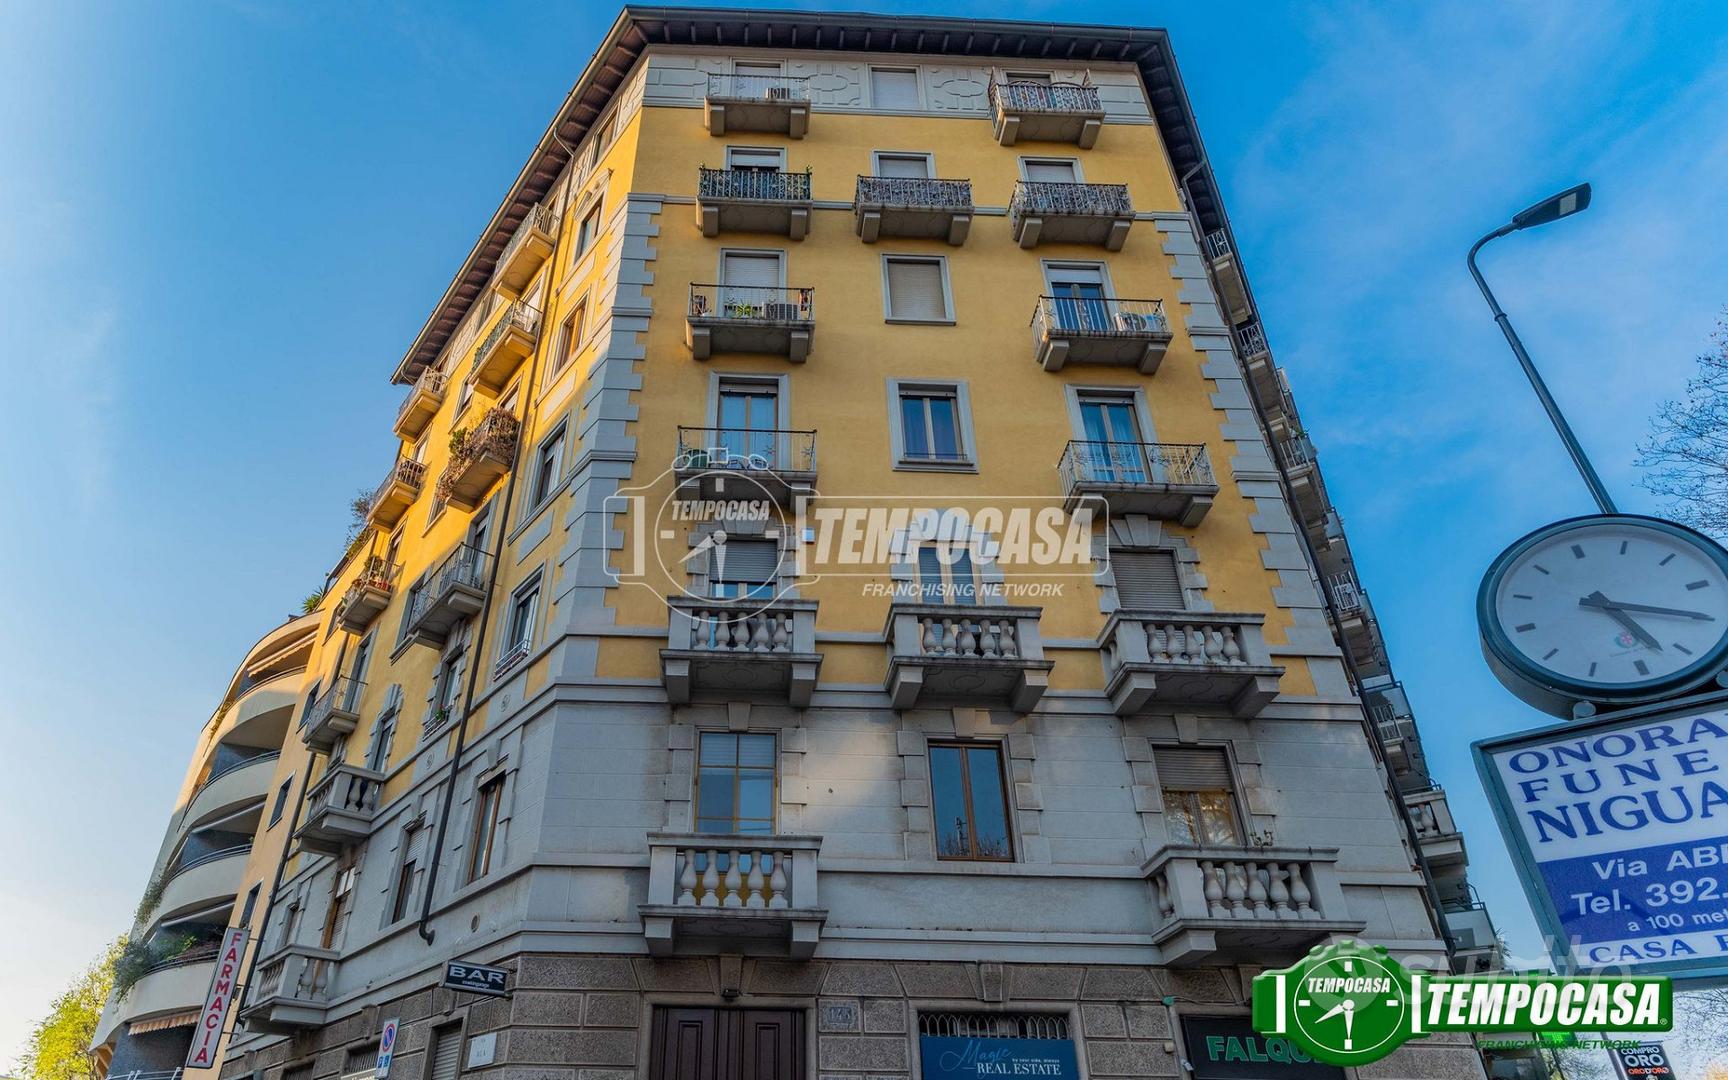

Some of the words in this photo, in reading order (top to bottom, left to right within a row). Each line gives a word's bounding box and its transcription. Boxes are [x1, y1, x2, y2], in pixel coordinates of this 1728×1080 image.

[1509, 713, 1728, 774] ONORA
[1518, 749, 1719, 803] FUNE
[1592, 858, 1648, 880] Via
[1571, 889, 1631, 915] Tel.
[1627, 921, 1640, 932] a
[1646, 914, 1684, 929] 100
[1589, 939, 1698, 963] CASA
[449, 966, 504, 984] BAR
[195, 932, 242, 1063] FARMACIA
[1206, 1036, 1324, 1064] FALQU
[1621, 1046, 1660, 1055] COMPRO
[1624, 1053, 1664, 1067] ORO
[977, 1062, 1011, 1074] REAL
[1014, 1062, 1061, 1075] ESTATE
